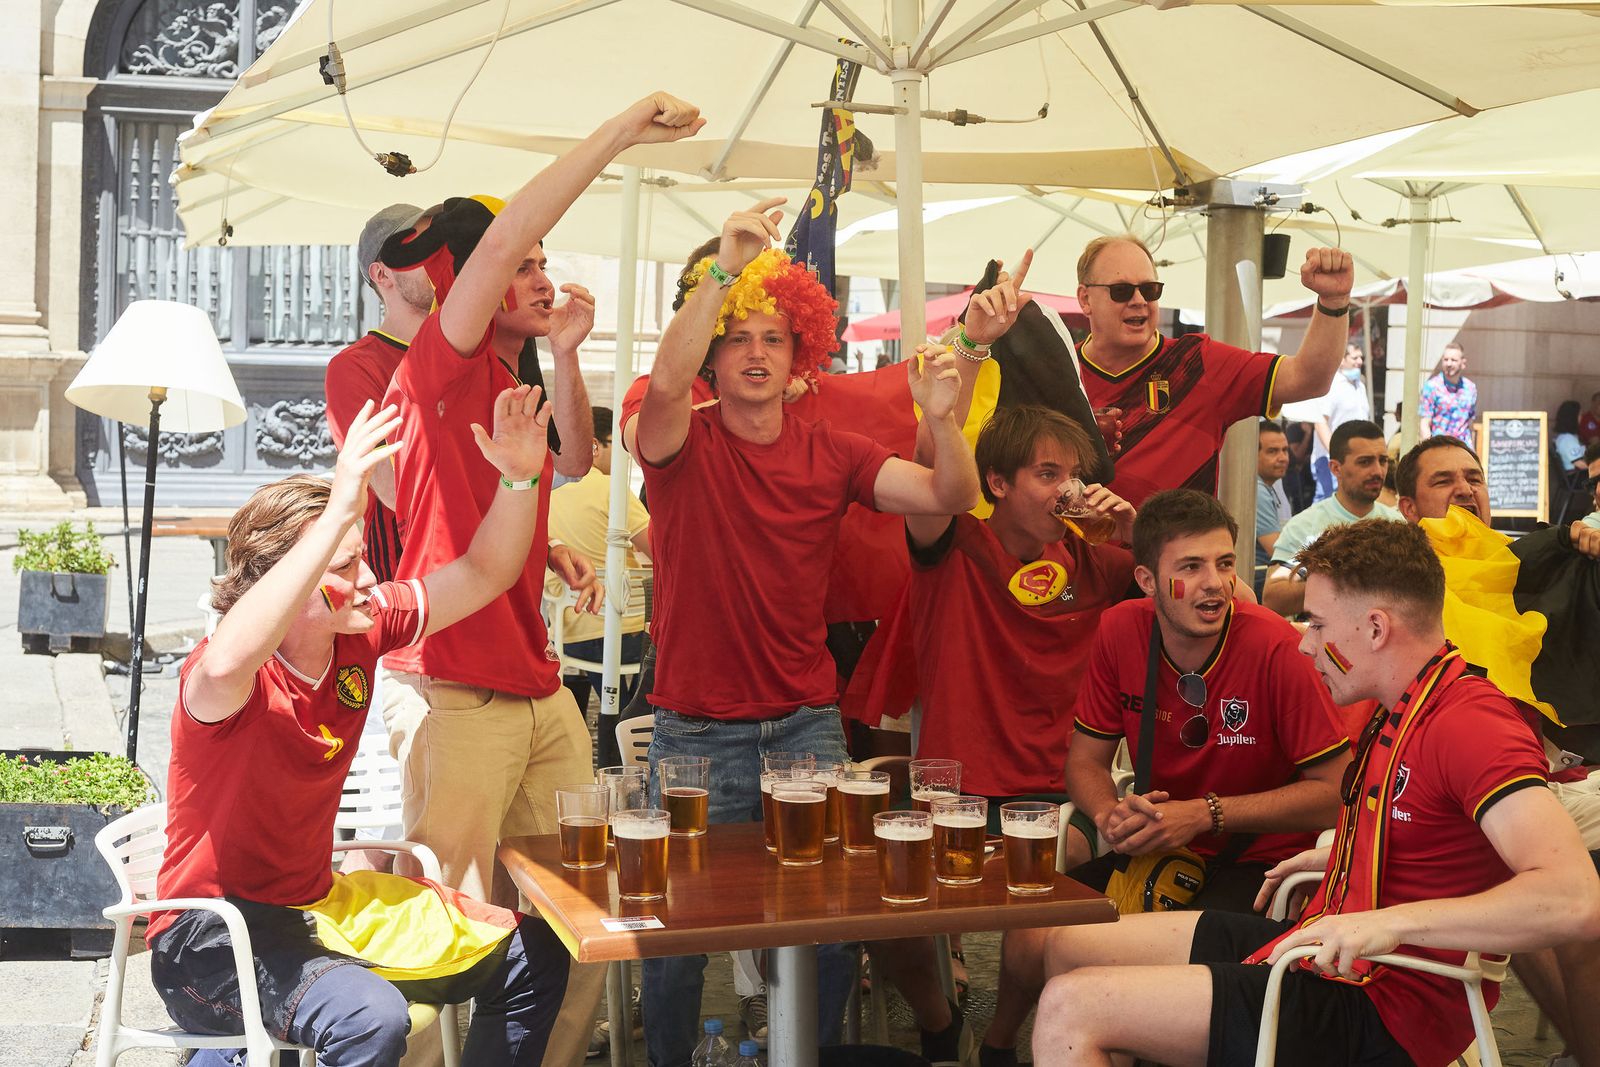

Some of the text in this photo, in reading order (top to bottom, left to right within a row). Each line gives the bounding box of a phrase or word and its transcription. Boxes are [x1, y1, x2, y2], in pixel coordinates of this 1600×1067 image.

[835, 61, 849, 102] NTES
[1216, 733, 1256, 746] Jupiler
[1392, 806, 1411, 822] iler
